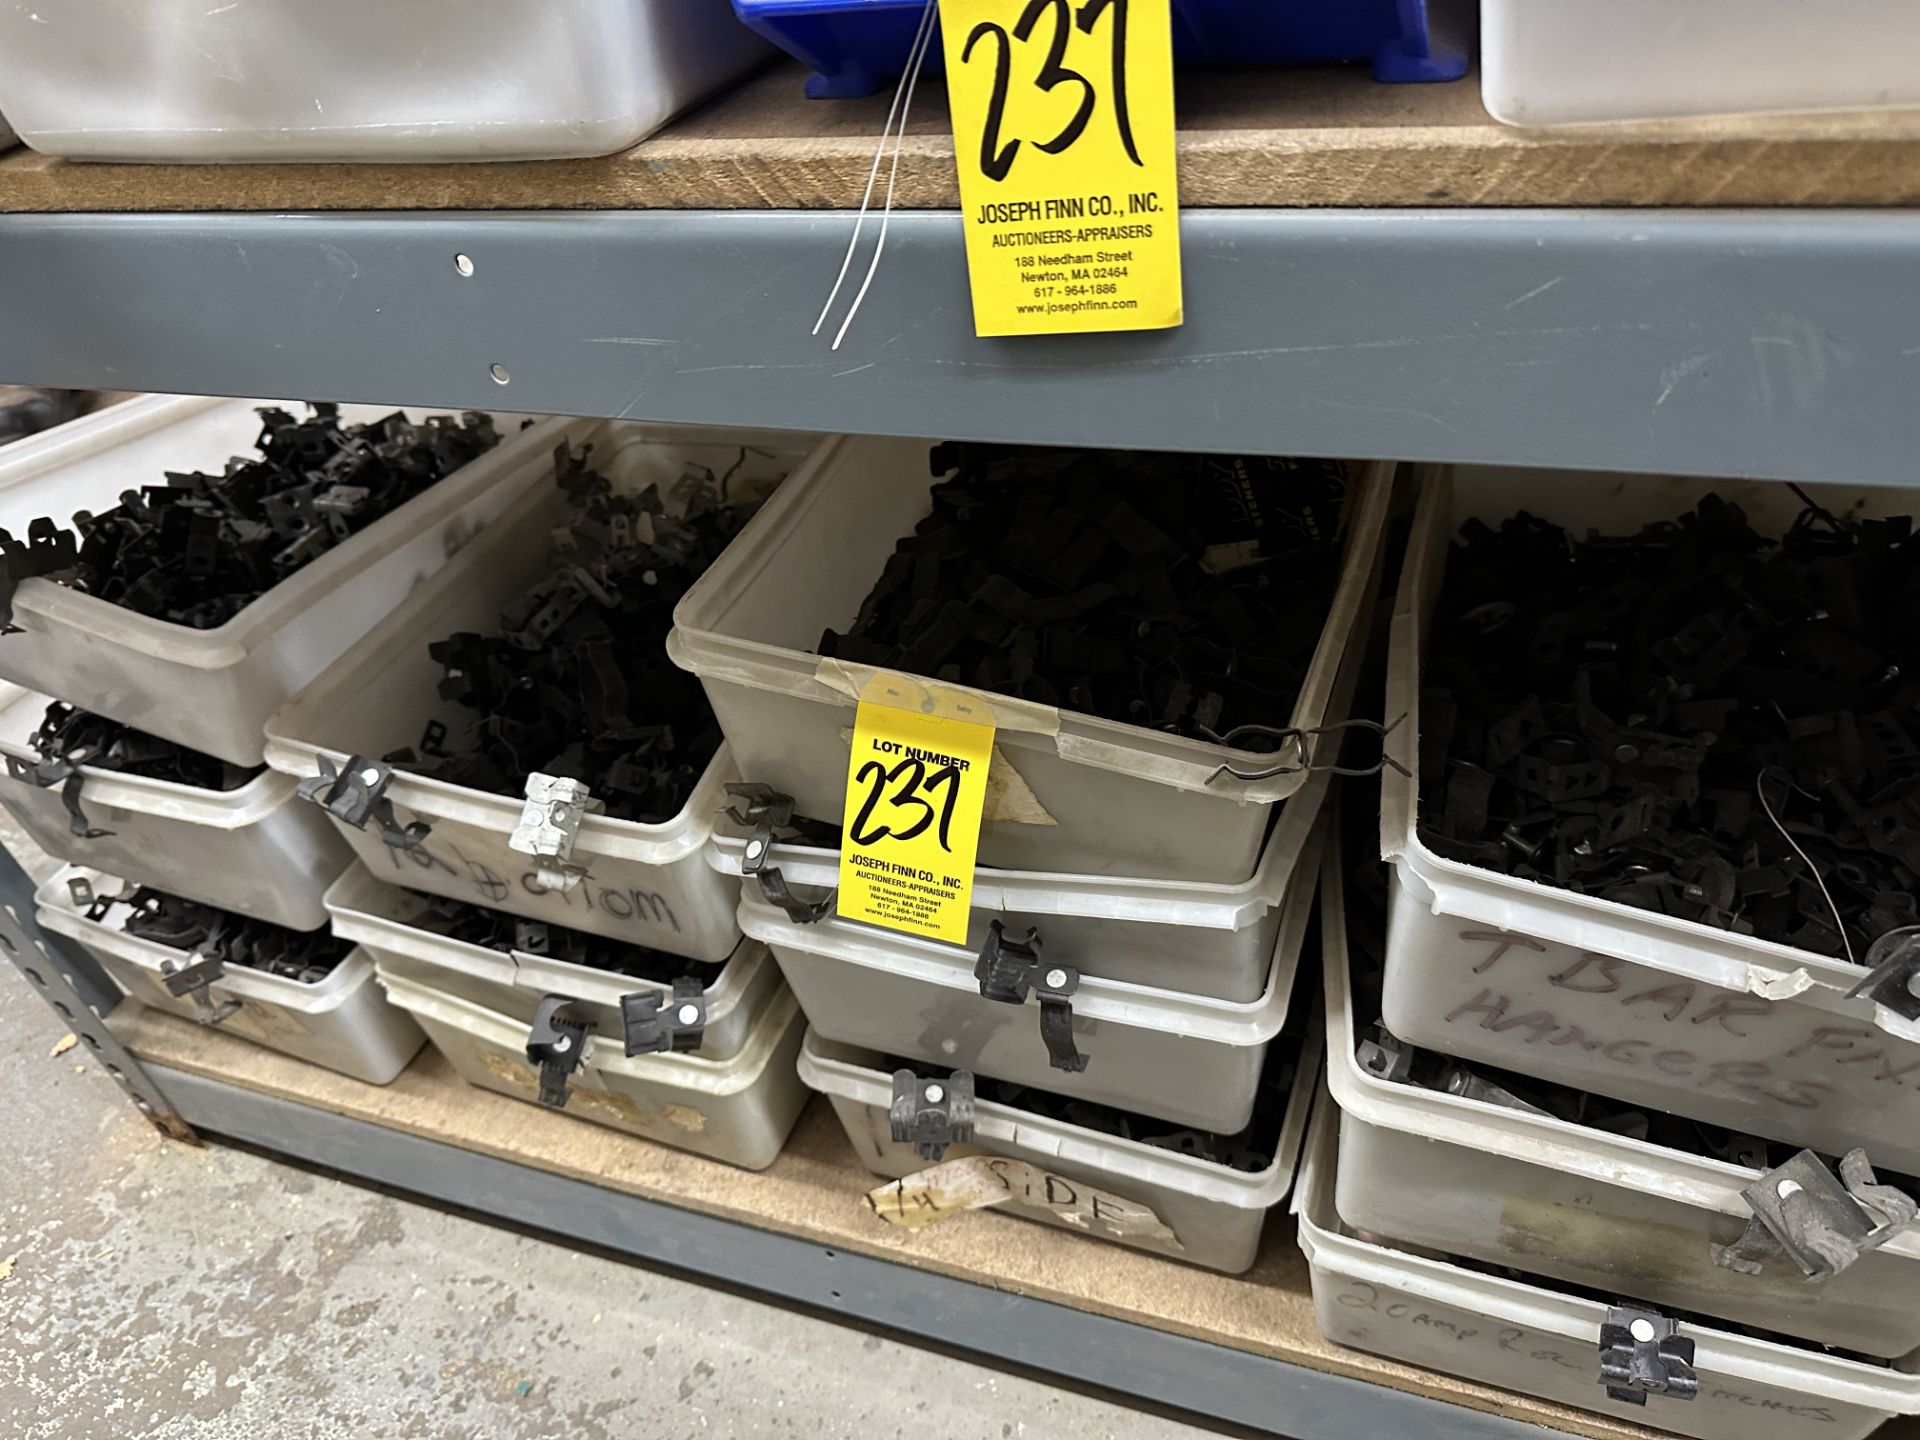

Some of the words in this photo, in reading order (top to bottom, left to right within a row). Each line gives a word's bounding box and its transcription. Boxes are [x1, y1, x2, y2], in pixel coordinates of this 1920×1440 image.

[961, 0, 1144, 182] 237
[978, 201, 1041, 224] JOSEPH
[1045, 198, 1084, 219] FINN
[1089, 195, 1124, 217] CO.,
[1128, 192, 1164, 213] INC.
[992, 225, 1153, 247] AUCTIONEERS-APPRAISERS
[1014, 257, 1035, 267] 188
[1038, 253, 1093, 266] Needham
[1096, 250, 1133, 262] Street
[1021, 271, 1068, 283] Newton,
[1072, 269, 1089, 280] MA
[1093, 267, 1128, 278] 02464
[1034, 287, 1054, 298] 617
[1064, 283, 1117, 296] 964-1886
[1017, 299, 1137, 315] www.josephfinn.com
[873, 738, 902, 756] LOT
[905, 746, 970, 772] NUMBER
[850, 758, 960, 853] 237
[849, 853, 889, 872] JOSEPH
[892, 864, 916, 878] FINN
[918, 870, 940, 886] CO.,
[943, 876, 963, 890] INC.
[856, 870, 956, 899] AUCTIONEERS-APPRAISERS
[870, 893, 900, 906] Newton,
[902, 901, 914, 909] MA
[877, 902, 890, 910] 617
[883, 888, 917, 902] Needham
[919, 896, 941, 907] Street
[865, 907, 941, 930] www.josephfinn.com
[1459, 930, 1547, 974] T
